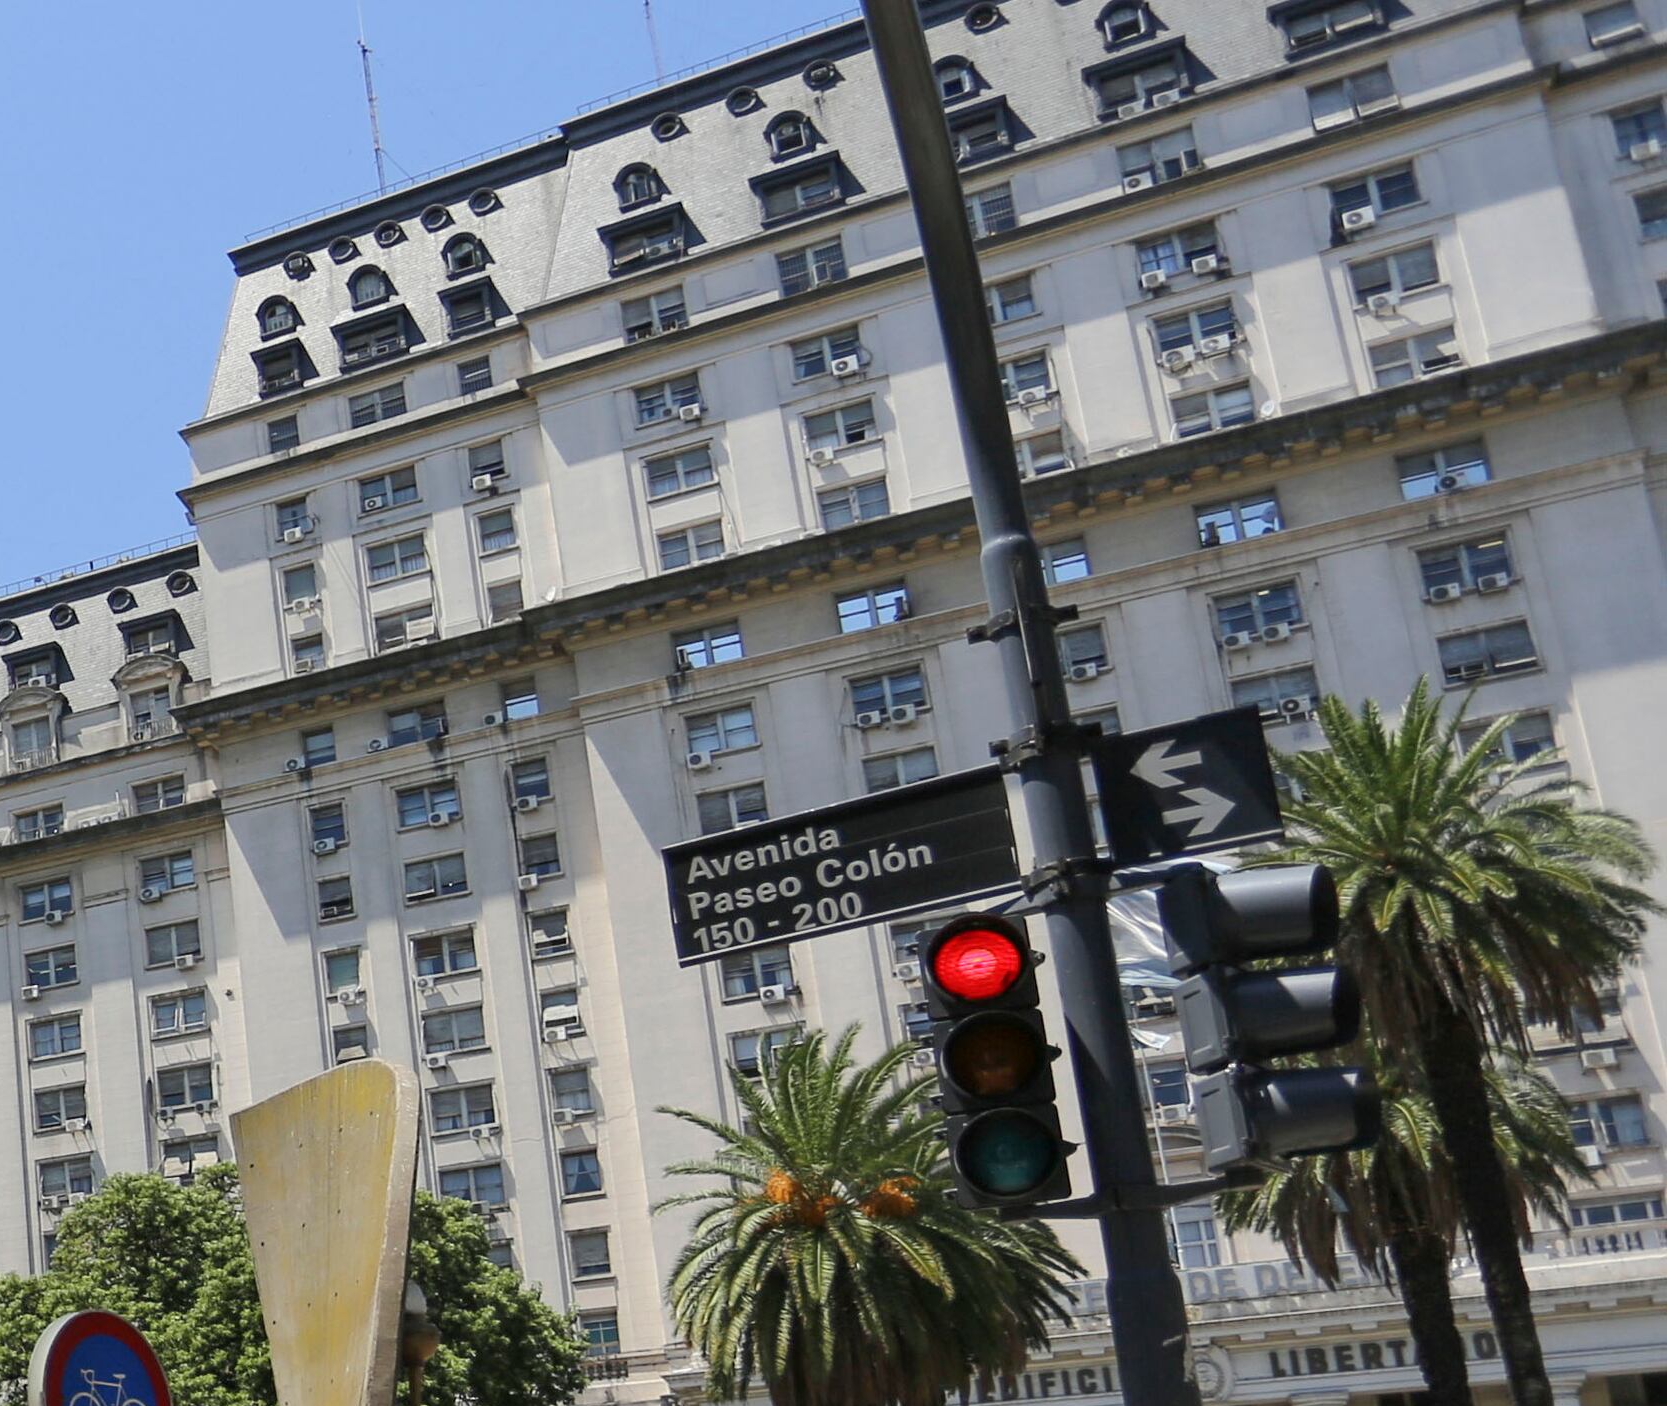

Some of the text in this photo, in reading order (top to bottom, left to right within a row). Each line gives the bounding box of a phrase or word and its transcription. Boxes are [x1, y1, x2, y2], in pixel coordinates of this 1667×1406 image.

[687, 827, 841, 885] Avenida
[687, 842, 933, 921] Paseo Colón
[693, 916, 755, 953] 150
[791, 891, 862, 932] 200
